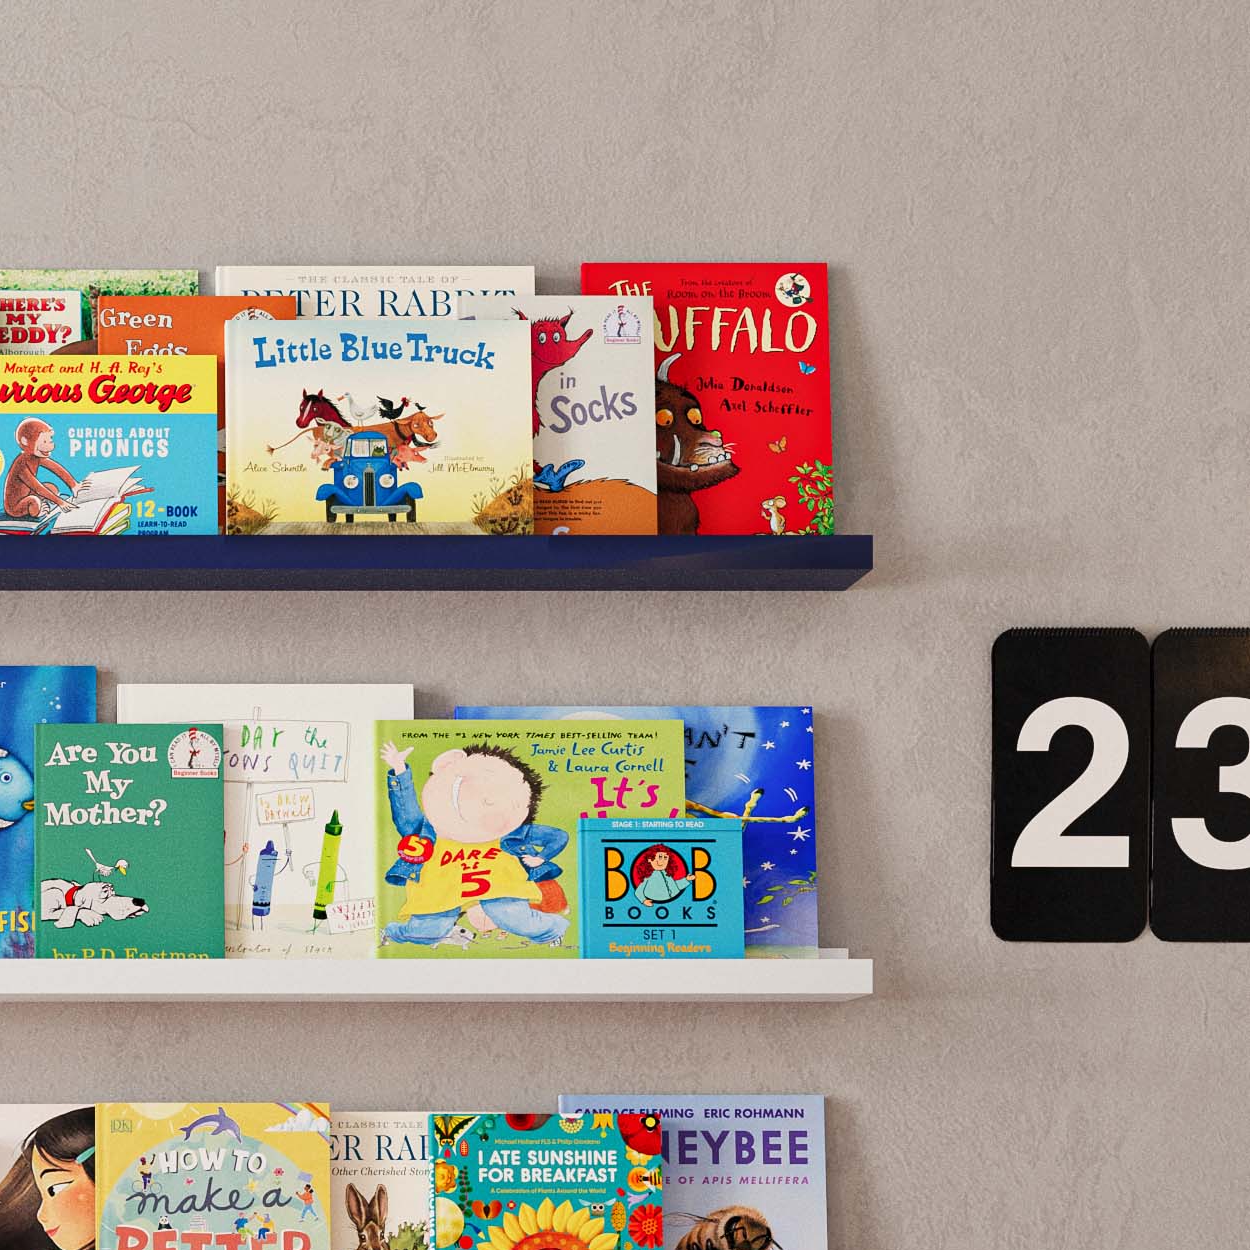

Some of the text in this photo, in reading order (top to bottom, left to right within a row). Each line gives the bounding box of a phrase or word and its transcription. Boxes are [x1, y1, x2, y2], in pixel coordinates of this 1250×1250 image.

[298, 275, 459, 284] THE CLASSIC TALE OF
[0, 298, 66, 312] HERE'S
[6, 313, 41, 325] MY
[100, 307, 173, 329] Green
[653, 305, 817, 353] UFFALO
[253, 332, 495, 370] Little Blue Truck
[4, 361, 162, 378] Margret and H. A. Rey's
[559, 372, 576, 390] in
[696, 376, 794, 394] Julia Donaldson
[87, 373, 193, 412] George
[549, 386, 638, 434] Socks
[720, 397, 814, 416] Axel Scheffler
[68, 427, 171, 438] CURIOUS ABOUT
[69, 439, 169, 457] PHONICS
[243, 461, 307, 473] Alice Schertle
[427, 462, 495, 474] Jill McElmurry
[240, 725, 328, 749] DAY the
[44, 742, 158, 767] Are You
[531, 742, 645, 756] Jamie Lee Curtis
[288, 751, 343, 780] QUIT
[548, 759, 664, 773] & Laura Cornell
[83, 770, 134, 800] My
[590, 776, 660, 809] It's
[44, 799, 168, 826] Mother?
[403, 836, 427, 857] 5
[440, 847, 502, 866] DARE
[461, 869, 491, 898] 5
[605, 906, 716, 920] BOOKS
[643, 929, 676, 940] SET 1
[609, 942, 712, 957] Beginning Readers
[704, 1108, 805, 1118] ERIC ROHMANN
[113, 1120, 131, 1131] DK
[337, 1121, 423, 1129] CLASSIC TALE
[157, 1148, 267, 1174] HOW TO
[478, 1150, 618, 1166] I ATE SUNSHINE
[331, 1166, 407, 1177] Other Cherished
[478, 1167, 617, 1183] FOR BREAKFAST
[678, 1176, 695, 1185] OF
[702, 1176, 733, 1185] APIS
[738, 1176, 810, 1185] MELLIFERA
[125, 1176, 293, 1215] make a
